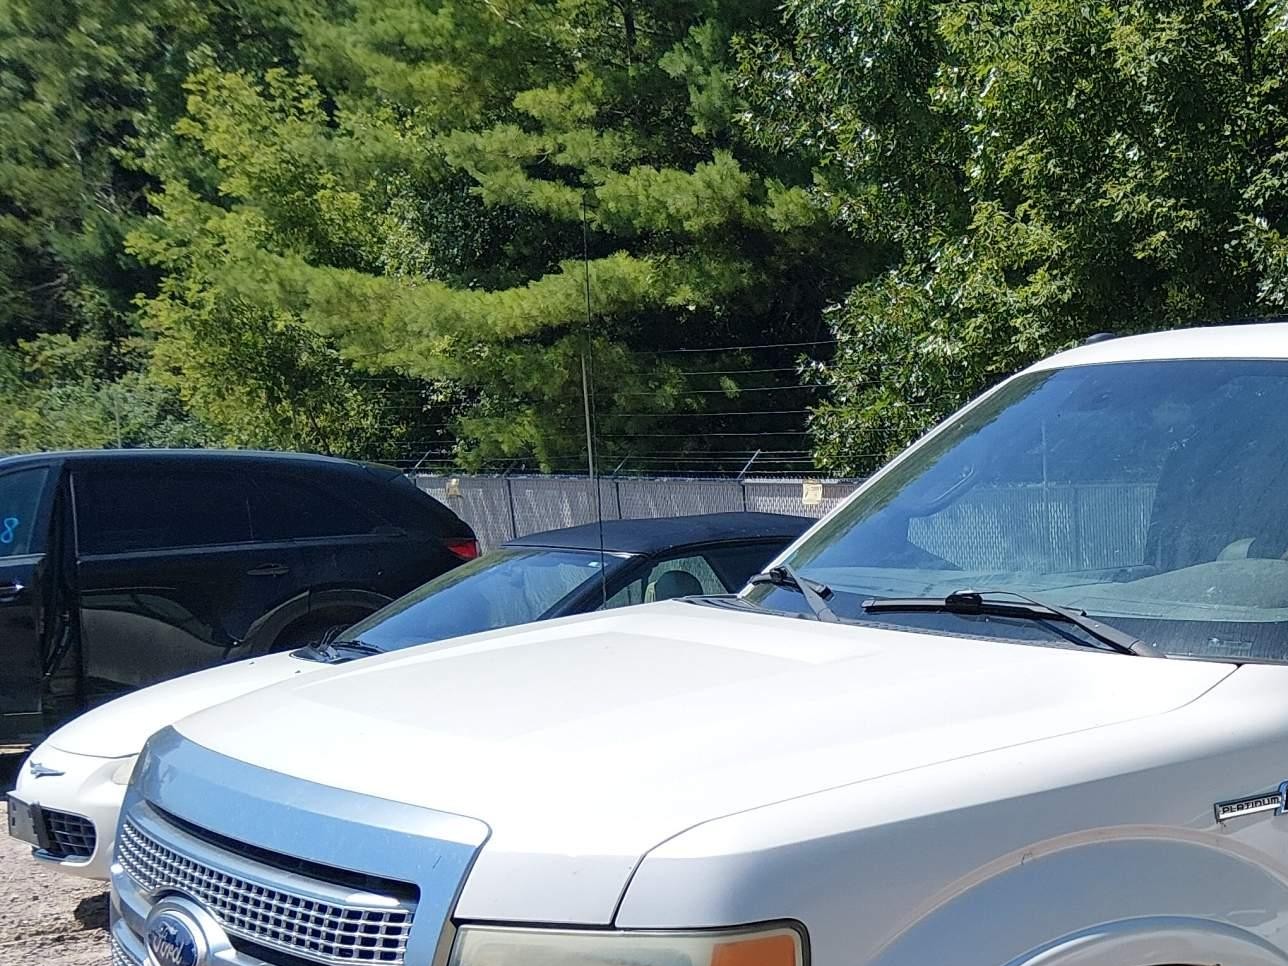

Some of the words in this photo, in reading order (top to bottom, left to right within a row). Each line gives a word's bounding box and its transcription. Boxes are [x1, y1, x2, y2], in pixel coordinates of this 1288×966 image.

[0, 517, 19, 544] 8
[1220, 795, 1281, 816] PLATINUM
[151, 921, 185, 966] Ford
